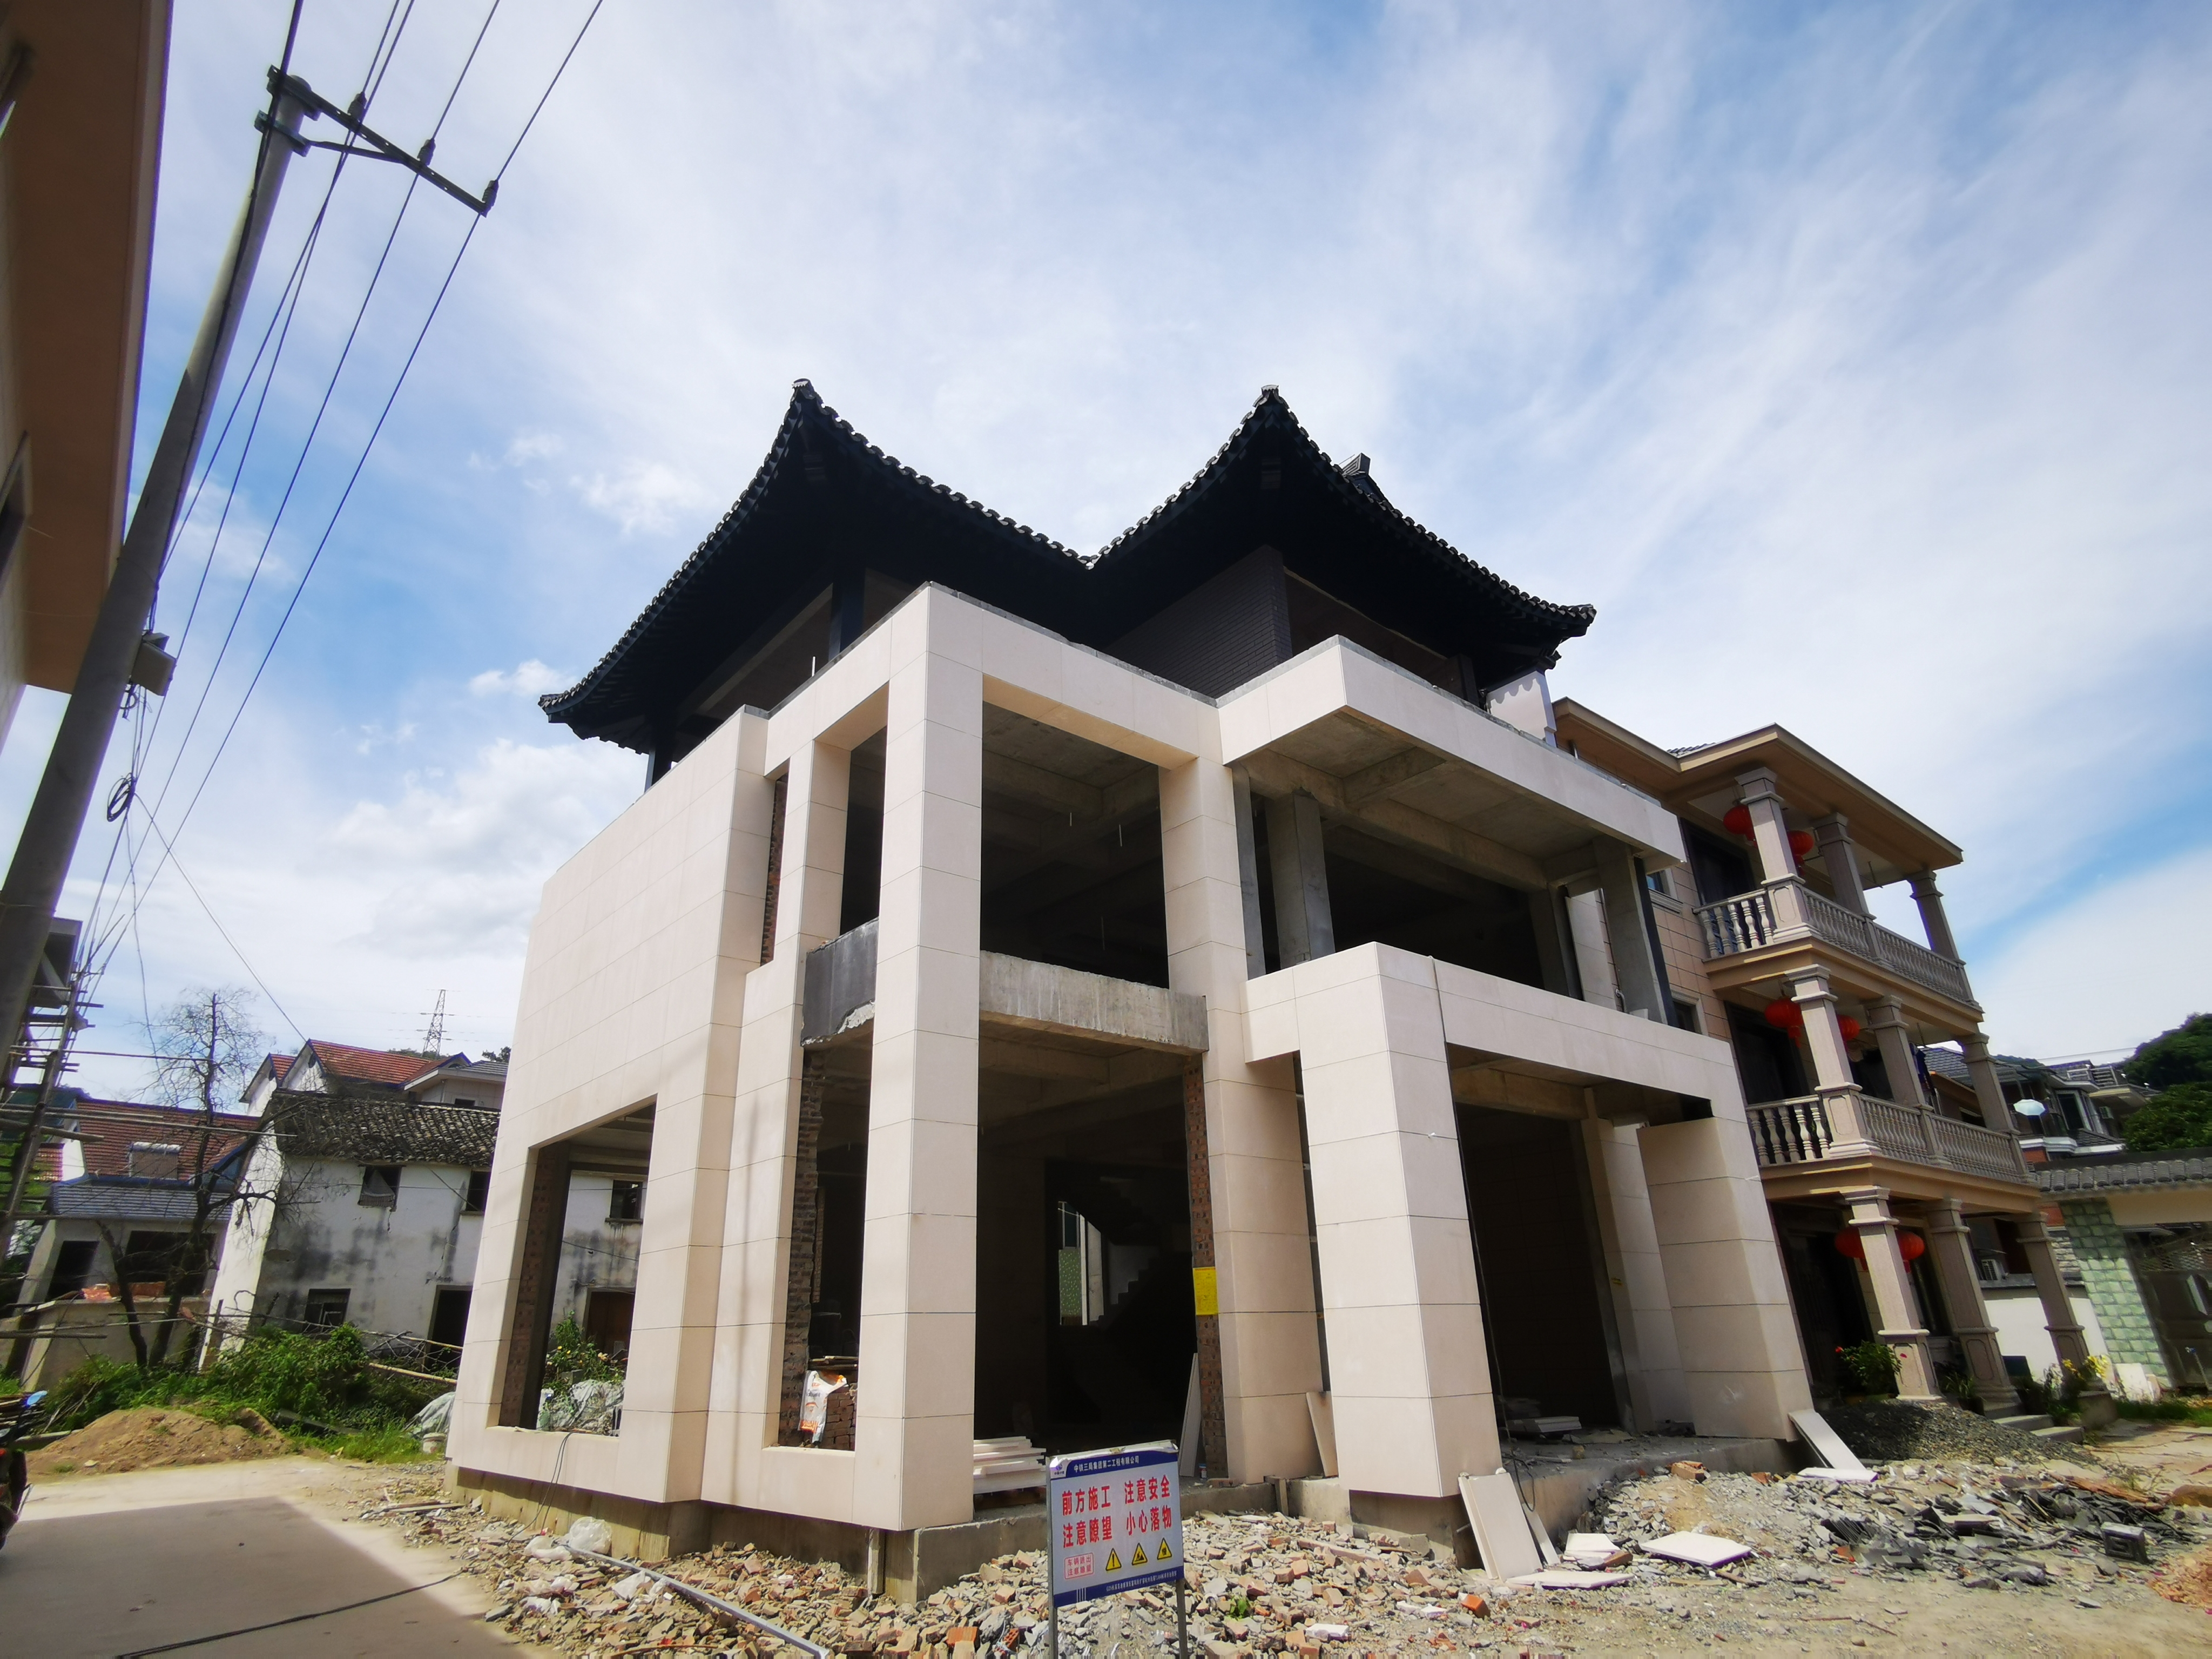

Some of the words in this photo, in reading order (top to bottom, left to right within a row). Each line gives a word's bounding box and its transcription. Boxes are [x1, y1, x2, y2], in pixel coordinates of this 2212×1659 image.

[1074, 1455, 1139, 1473] 中铁三局集团第二工程有限公司
[1062, 1486, 1111, 1516] 前方施工
[1124, 1474, 1170, 1504] 注意安全
[1063, 1515, 1112, 1548] 注意瞭望
[1126, 1505, 1172, 1536] 小心落物
